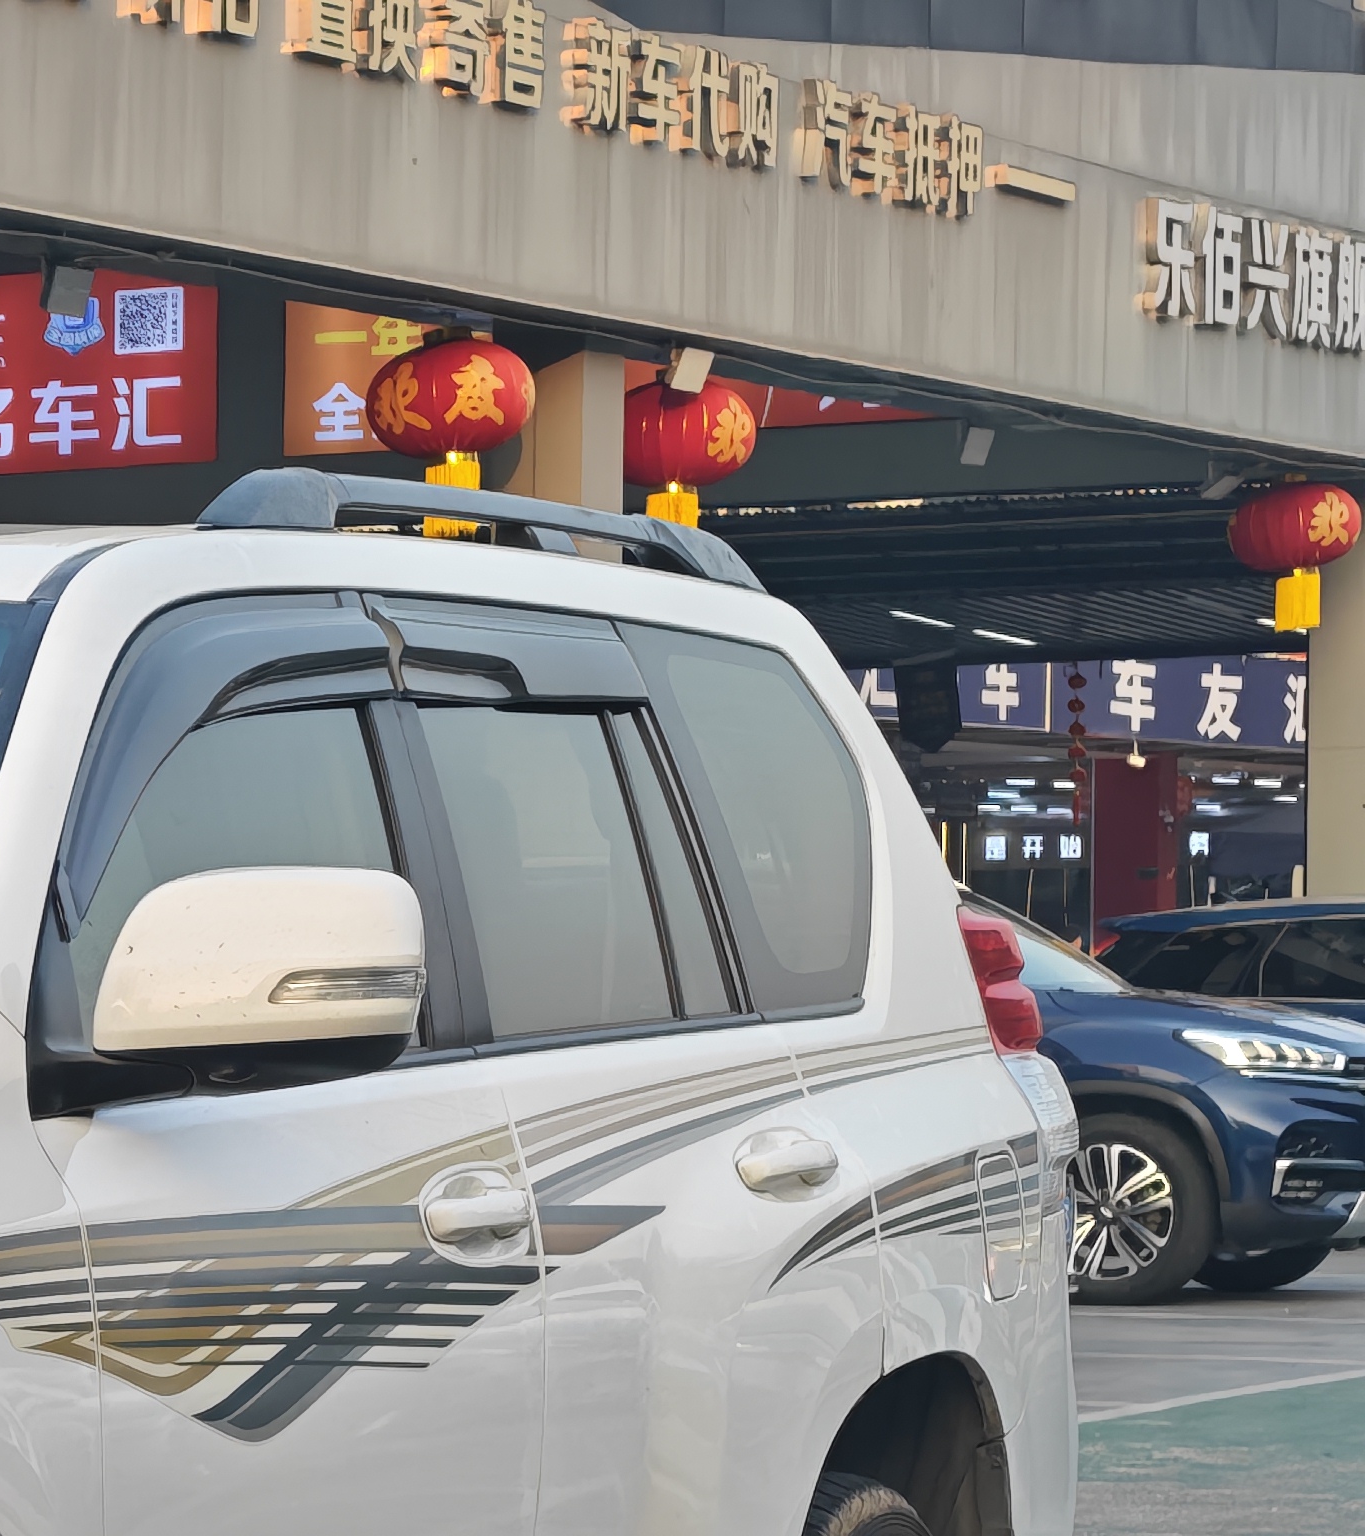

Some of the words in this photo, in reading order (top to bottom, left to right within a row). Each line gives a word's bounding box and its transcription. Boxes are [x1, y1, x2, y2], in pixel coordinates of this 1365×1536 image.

[581, 20, 780, 168] 新车代购
[801, 78, 986, 217] 汽车抵押
